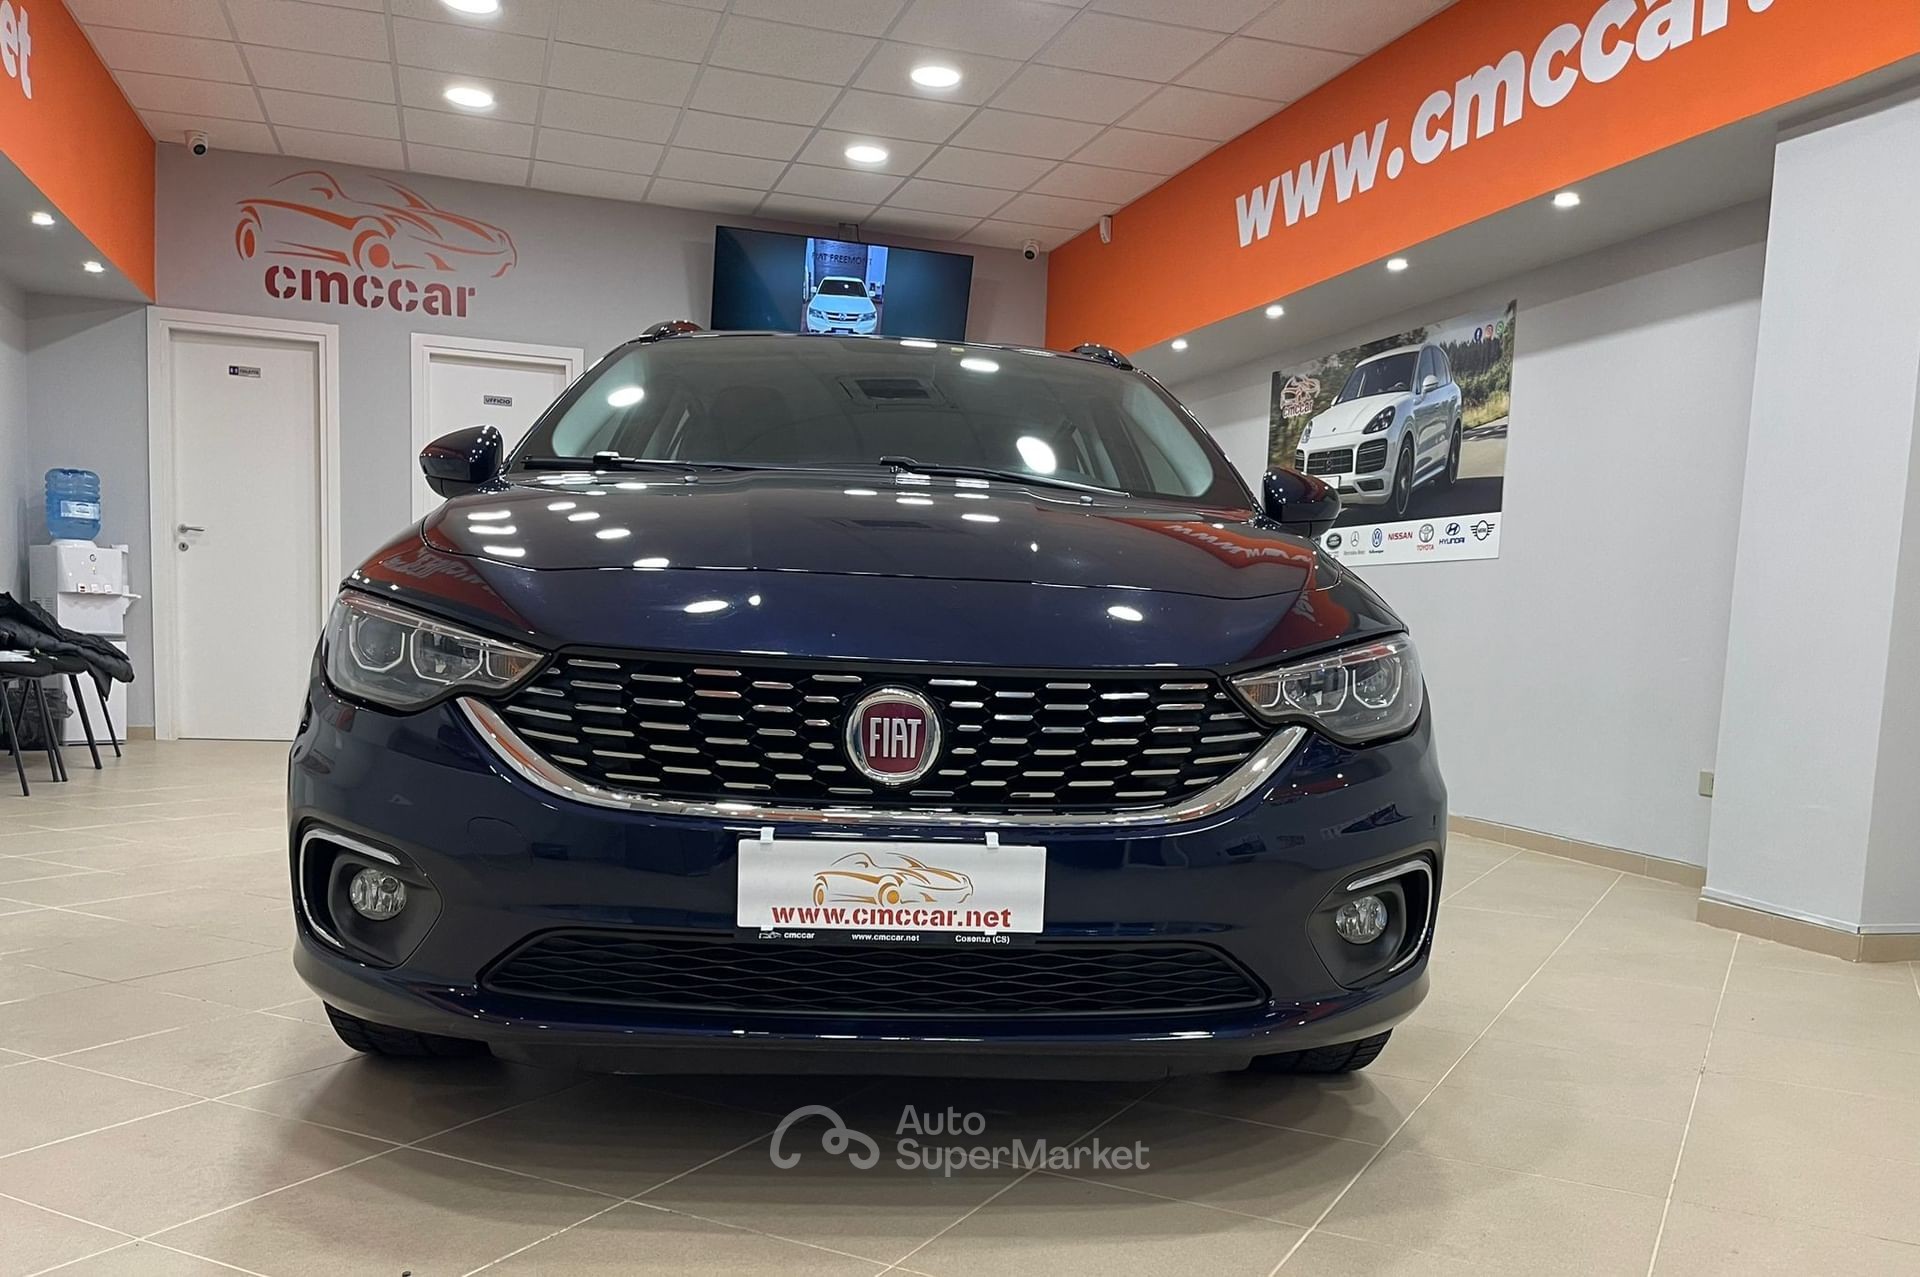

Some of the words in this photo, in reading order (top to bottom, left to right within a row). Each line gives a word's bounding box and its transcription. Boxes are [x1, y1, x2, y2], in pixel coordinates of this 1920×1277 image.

[1235, 0, 1775, 247] www.cmcca
[264, 264, 476, 318] cmccar
[1387, 531, 1413, 541] NISSAN
[1439, 536, 1465, 545] HYUNDAI
[869, 716, 922, 759] FIAT
[771, 906, 1011, 928] www.cmccar.net
[783, 931, 816, 940] cmccar
[851, 933, 920, 942] www.cmccar.net
[955, 935, 991, 943] Cosenza
[992, 935, 1010, 944] (CS)
